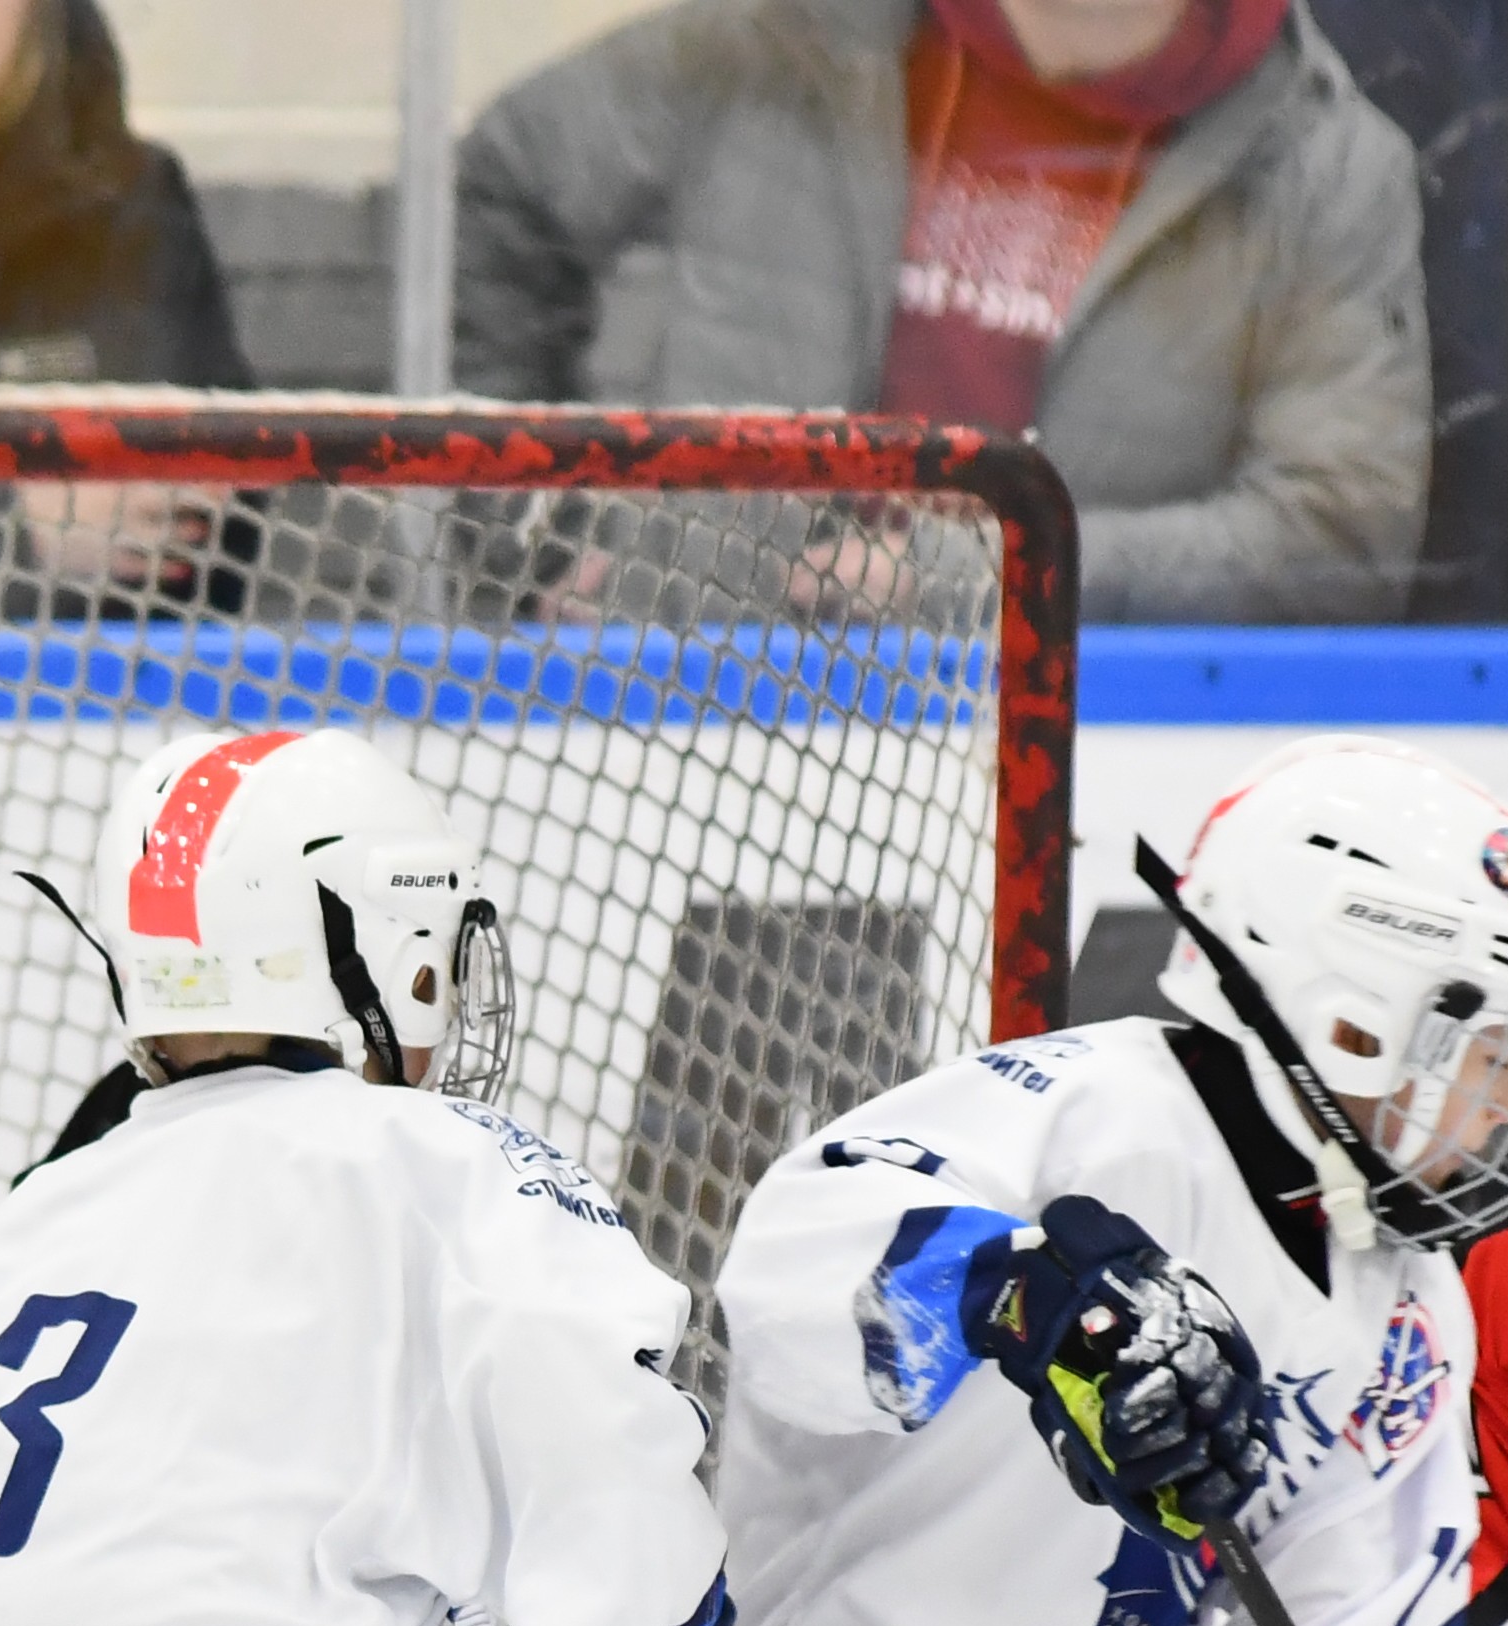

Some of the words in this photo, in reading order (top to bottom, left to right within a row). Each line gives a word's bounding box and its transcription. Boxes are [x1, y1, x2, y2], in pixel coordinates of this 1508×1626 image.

[390, 874, 447, 888] BAUER
[1342, 901, 1459, 943] BAUER
[1287, 1063, 1360, 1145] BAUER
